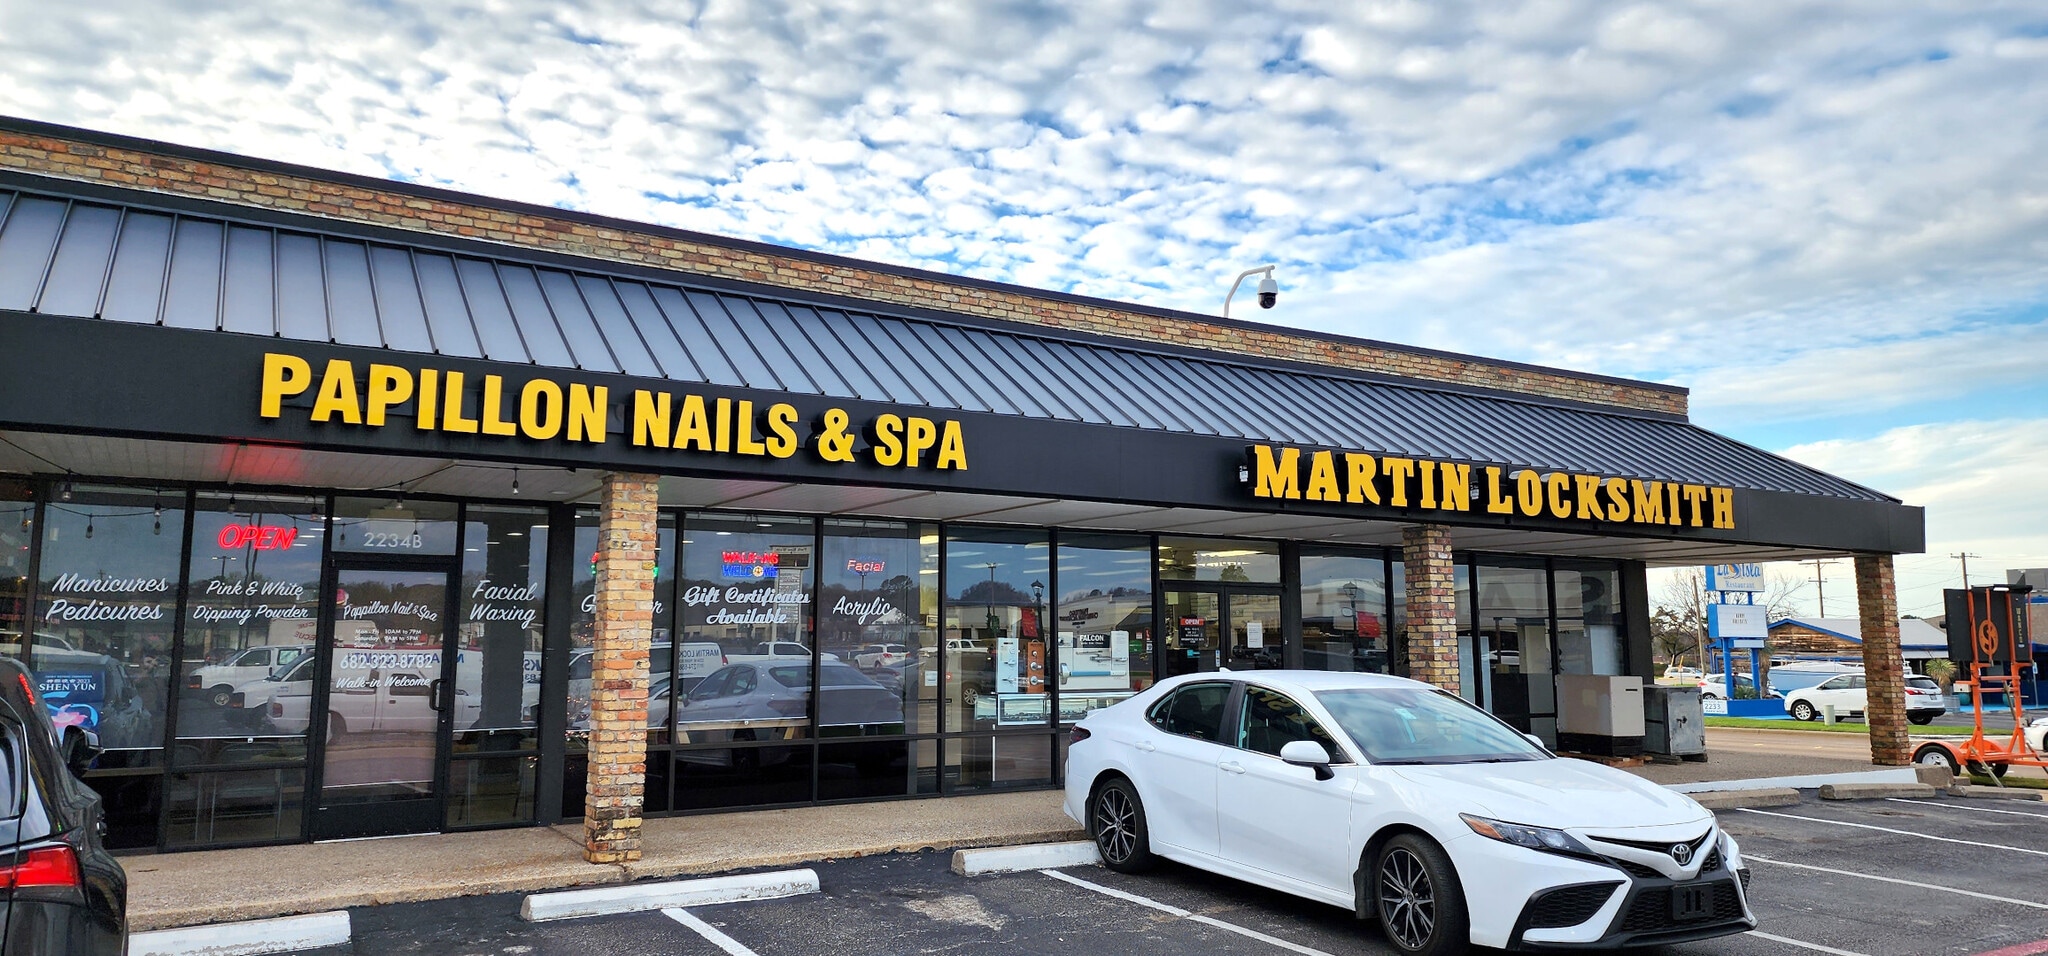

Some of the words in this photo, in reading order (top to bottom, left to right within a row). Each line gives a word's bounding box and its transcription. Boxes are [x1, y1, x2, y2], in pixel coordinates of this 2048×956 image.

[260, 352, 609, 444] PAPILLON
[632, 388, 799, 460] NAILS
[817, 407, 857, 463] &
[874, 413, 968, 471] SPA
[1252, 443, 1472, 512] MARTIN
[1485, 465, 1736, 530] LOCKSMITH
[217, 523, 297, 551] OPEN
[363, 531, 423, 549] 2234B
[846, 559, 886, 572] Facial
[51, 572, 169, 593] Manicures
[205, 580, 243, 596] Pink
[245, 580, 258, 596] &
[260, 580, 304, 601] White
[471, 579, 538, 601] Facial
[681, 585, 721, 607] Gift
[724, 586, 811, 607] Certificates
[45, 598, 164, 621] Pedicures
[192, 605, 252, 626] Dipping
[254, 604, 309, 618] Powder
[390, 600, 412, 615] Nail
[417, 605, 438, 622] Spa
[469, 602, 537, 630] Waxing
[706, 607, 788, 625] Available
[832, 595, 892, 626] Acrylic
[1079, 634, 1104, 642] FALCON
[340, 654, 433, 669] 682-323-8782
[39, 683, 71, 691] SHEN
[72, 683, 97, 691] YUN
[335, 676, 382, 689] Walk-in
[385, 675, 431, 688] Welcome
